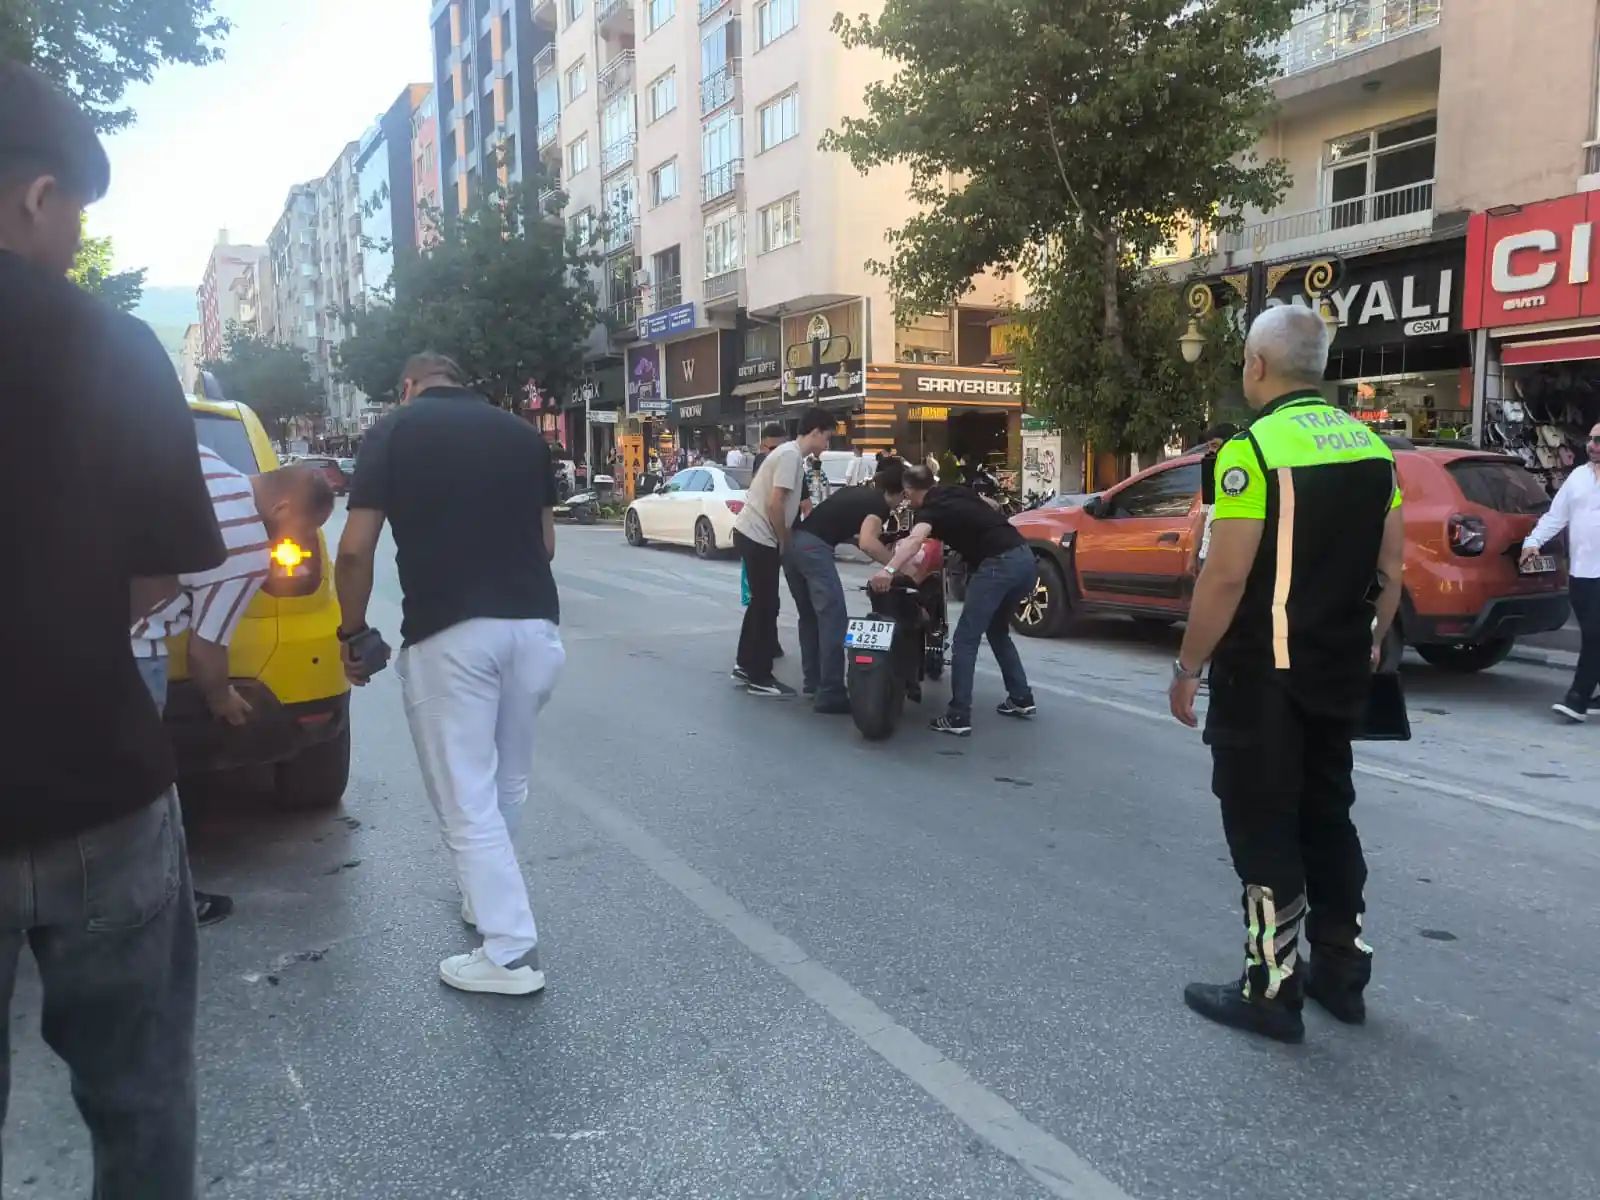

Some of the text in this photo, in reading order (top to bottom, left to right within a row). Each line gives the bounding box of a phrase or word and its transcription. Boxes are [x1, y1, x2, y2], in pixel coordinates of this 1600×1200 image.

[1412, 320, 1441, 333] GSM
[682, 358, 695, 382] W
[1289, 409, 1346, 429] TRAF
[850, 621, 893, 634] 43 ADT
[856, 634, 878, 645] 425
